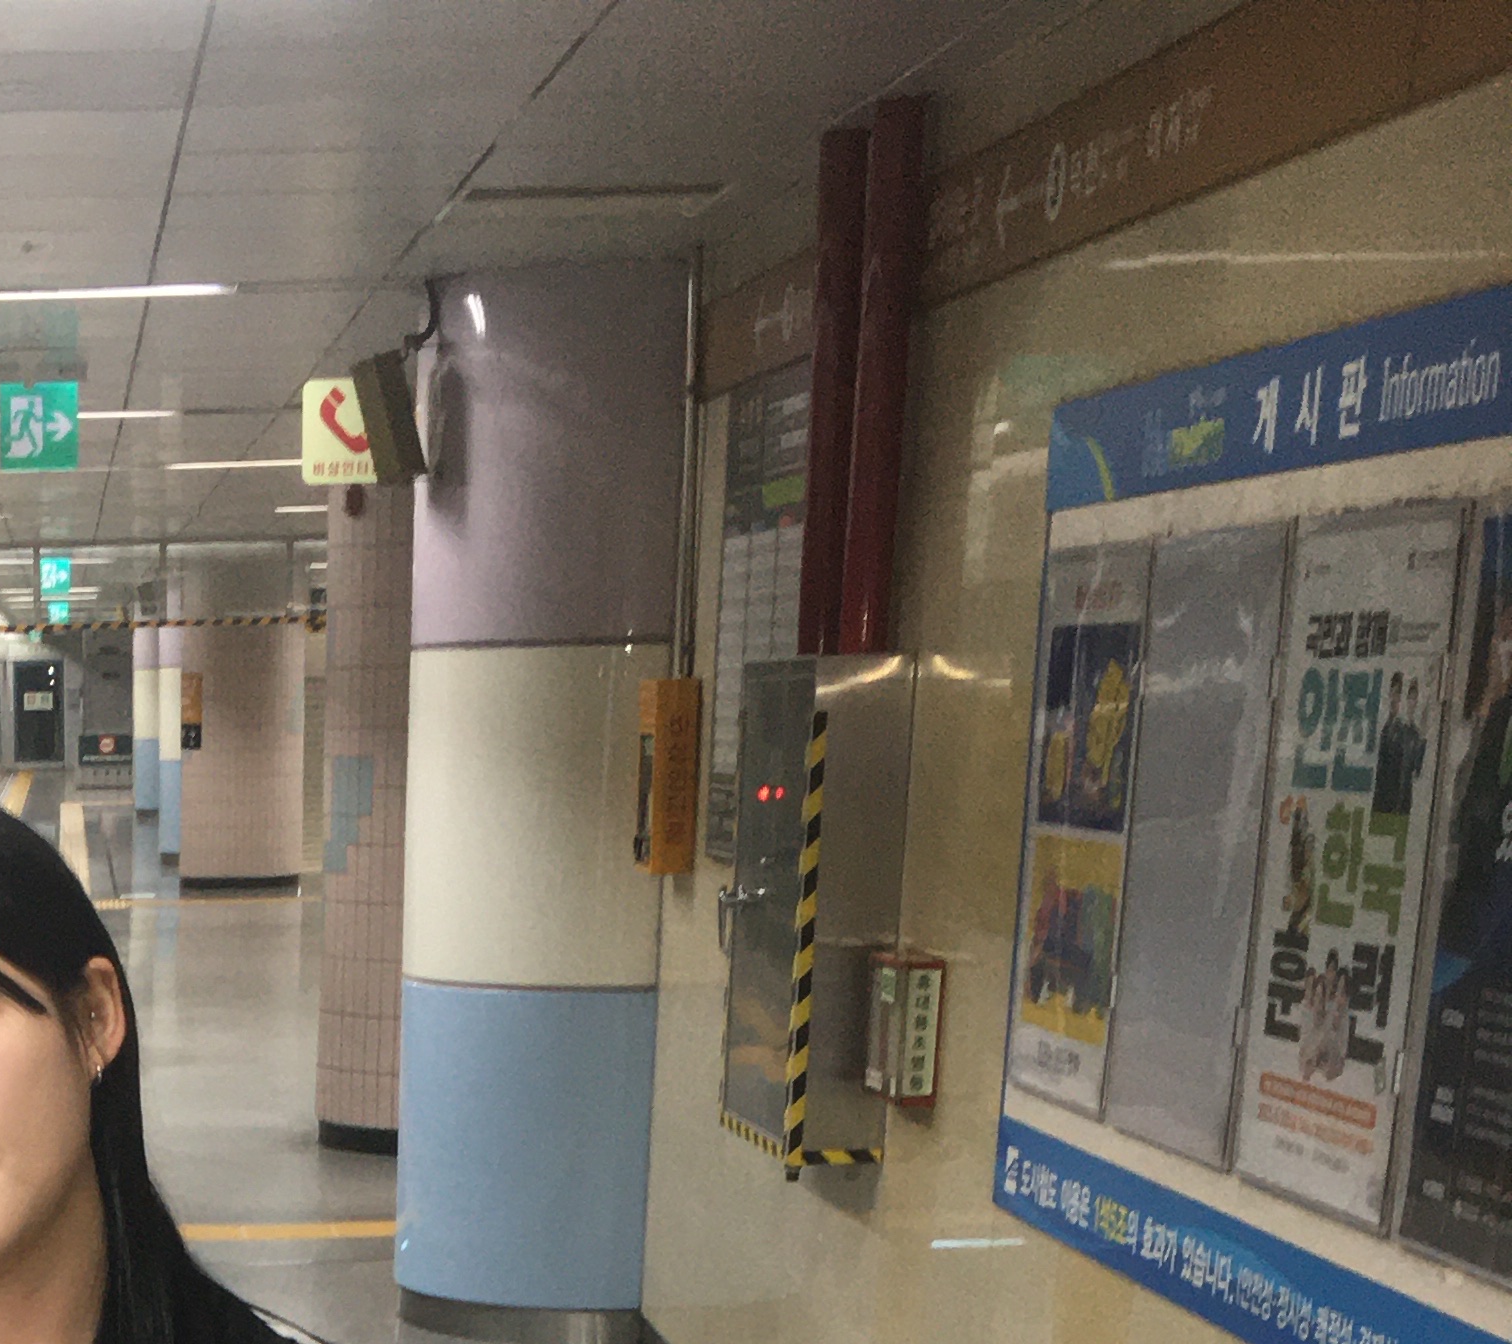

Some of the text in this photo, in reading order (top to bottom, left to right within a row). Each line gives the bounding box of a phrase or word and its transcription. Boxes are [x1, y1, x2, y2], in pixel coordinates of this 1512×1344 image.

[1378, 337, 1500, 422] Information
[314, 462, 372, 477] 비상인터
[1291, 667, 1383, 792] 안전
[1315, 801, 1410, 937] 한국
[1140, 1216, 1178, 1275] 효과가
